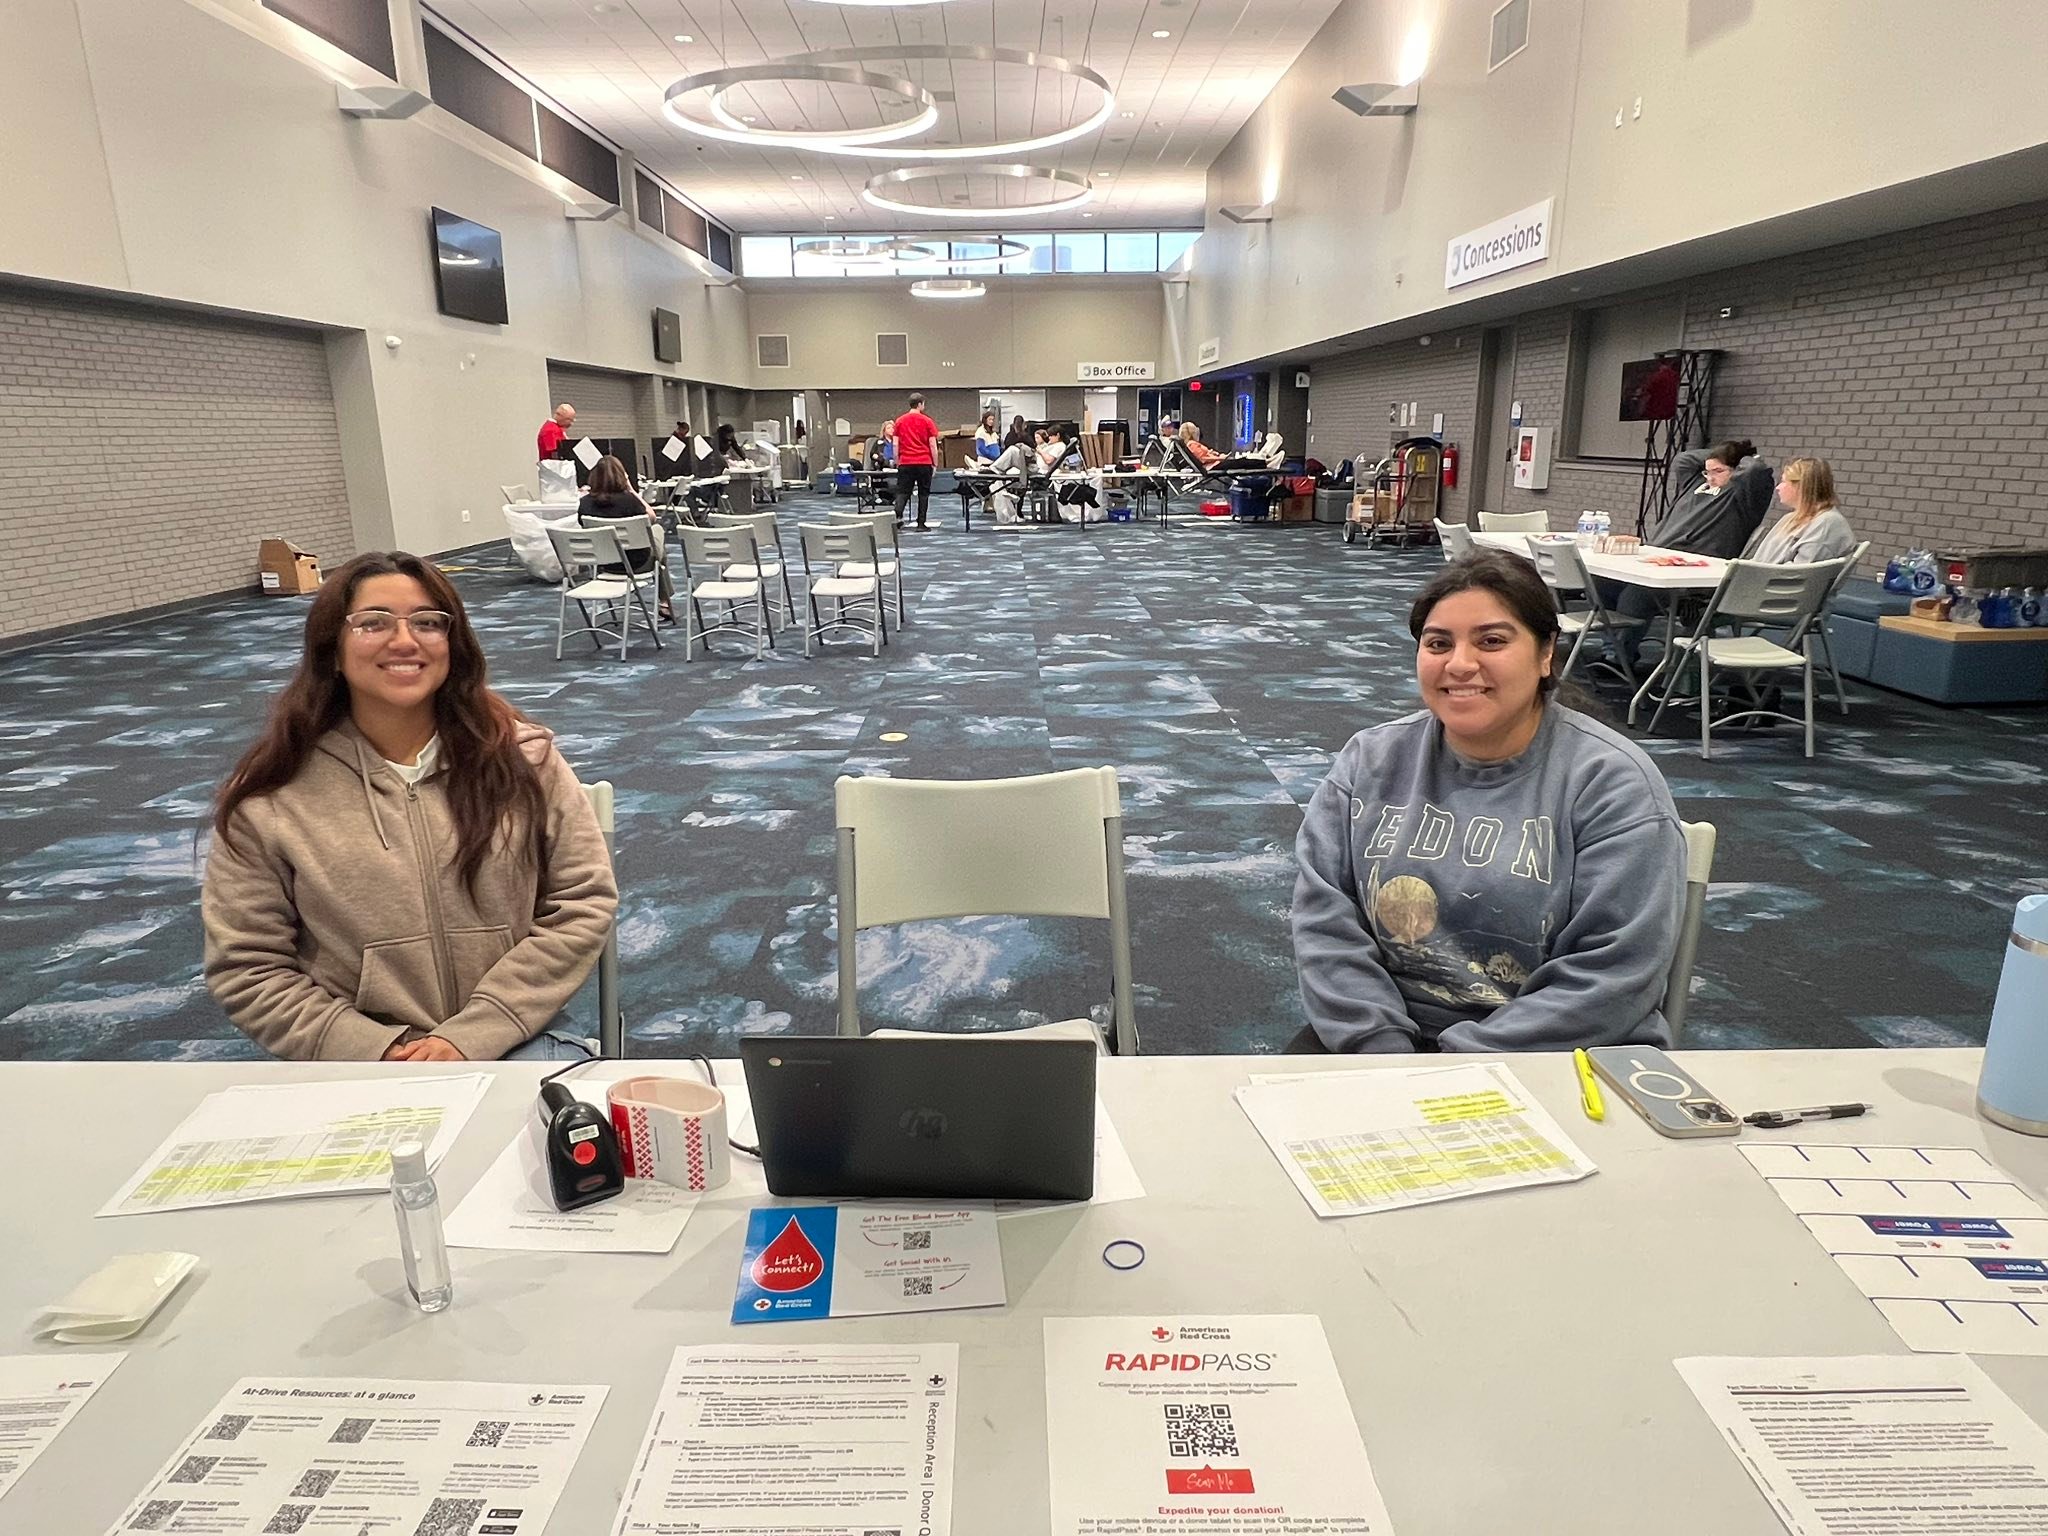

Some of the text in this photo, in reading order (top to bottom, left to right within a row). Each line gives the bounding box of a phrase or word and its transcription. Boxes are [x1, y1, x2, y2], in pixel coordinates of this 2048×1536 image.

[1463, 222, 1543, 271] Concessions
[1093, 365, 1147, 376] Box Office
[775, 1254, 802, 1266] Let's
[761, 1262, 814, 1275] Connect!
[242, 1387, 288, 1396] At-Drive
[290, 1389, 351, 1398] Resources:
[376, 1391, 416, 1401] glance
[925, 1401, 940, 1452] Reception
[923, 1453, 936, 1478] Area
[1187, 1473, 1215, 1490] Scan
[920, 1490, 934, 1525] Donor
[1158, 1506, 1285, 1516] Expedite your donation!
